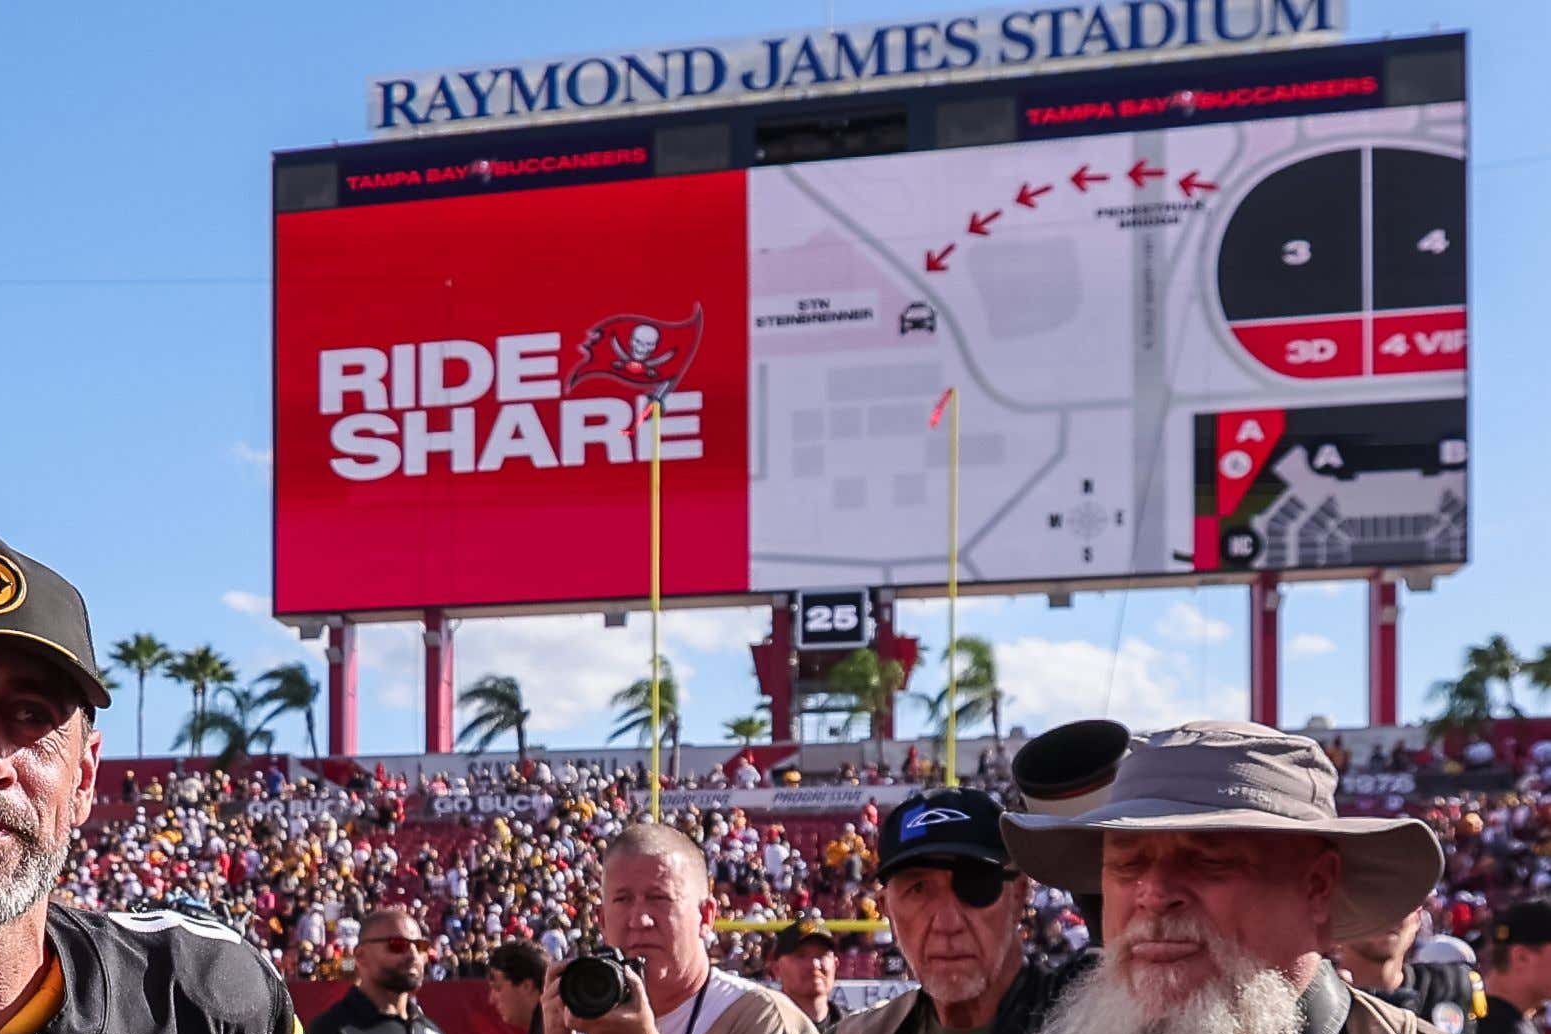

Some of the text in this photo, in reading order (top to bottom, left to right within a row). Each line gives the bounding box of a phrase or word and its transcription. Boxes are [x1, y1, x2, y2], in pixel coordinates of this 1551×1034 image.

[375, 0, 1335, 128] RAYMOND JAMES STADIUM
[1026, 75, 1378, 126] TAMPA BAY BUCCANEERS
[346, 147, 647, 191] TAMPA BAY BUCCANEERS
[1281, 228, 1450, 266] 3 4
[1284, 338, 1339, 365] 3D
[1378, 332, 1410, 357] 4
[318, 332, 563, 416] RIDE
[330, 390, 705, 482] SHARE
[805, 604, 859, 633] 25
